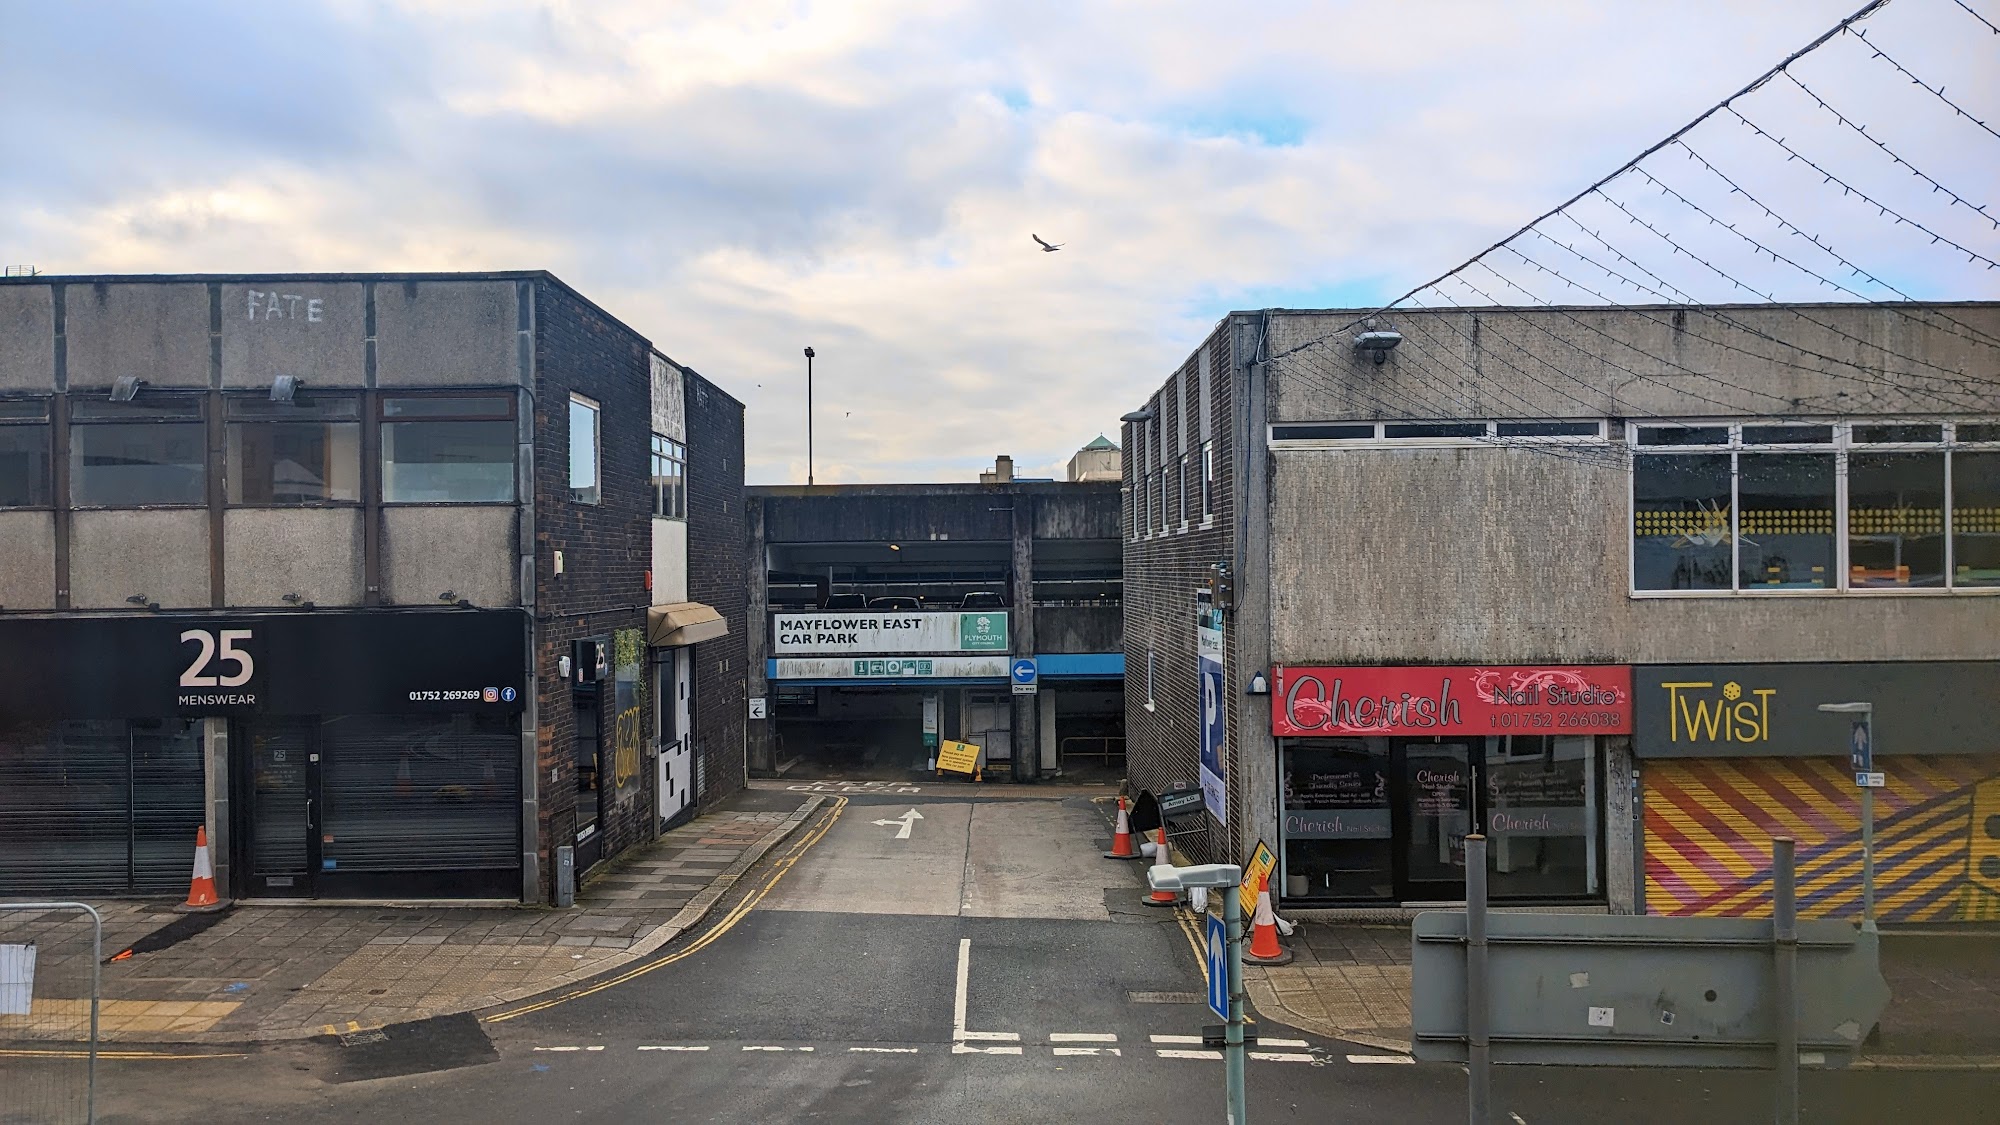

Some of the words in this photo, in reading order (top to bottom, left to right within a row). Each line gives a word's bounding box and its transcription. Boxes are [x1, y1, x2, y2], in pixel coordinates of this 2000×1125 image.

[248, 289, 324, 322] FATE
[780, 618, 878, 631] MAYFLOWER
[883, 618, 922, 629] EAST
[780, 633, 812, 645] CAR
[817, 633, 858, 644] PARK
[180, 629, 254, 687] 25
[178, 694, 256, 706] MENSWEAR
[409, 691, 440, 700] 01752
[443, 690, 480, 700] 269269
[1286, 675, 1462, 730] Cherish
[1494, 684, 1540, 706] Nail
[1547, 684, 1616, 706] Studio
[1205, 671, 1216, 753] P
[1558, 712, 1620, 727] 266038
[275, 751, 285, 759] 25
[1416, 769, 1460, 783] Cherish
[786, 785, 922, 793] CLEAR
[1285, 815, 1343, 834] Cherish
[1492, 813, 1549, 832] Cherish
